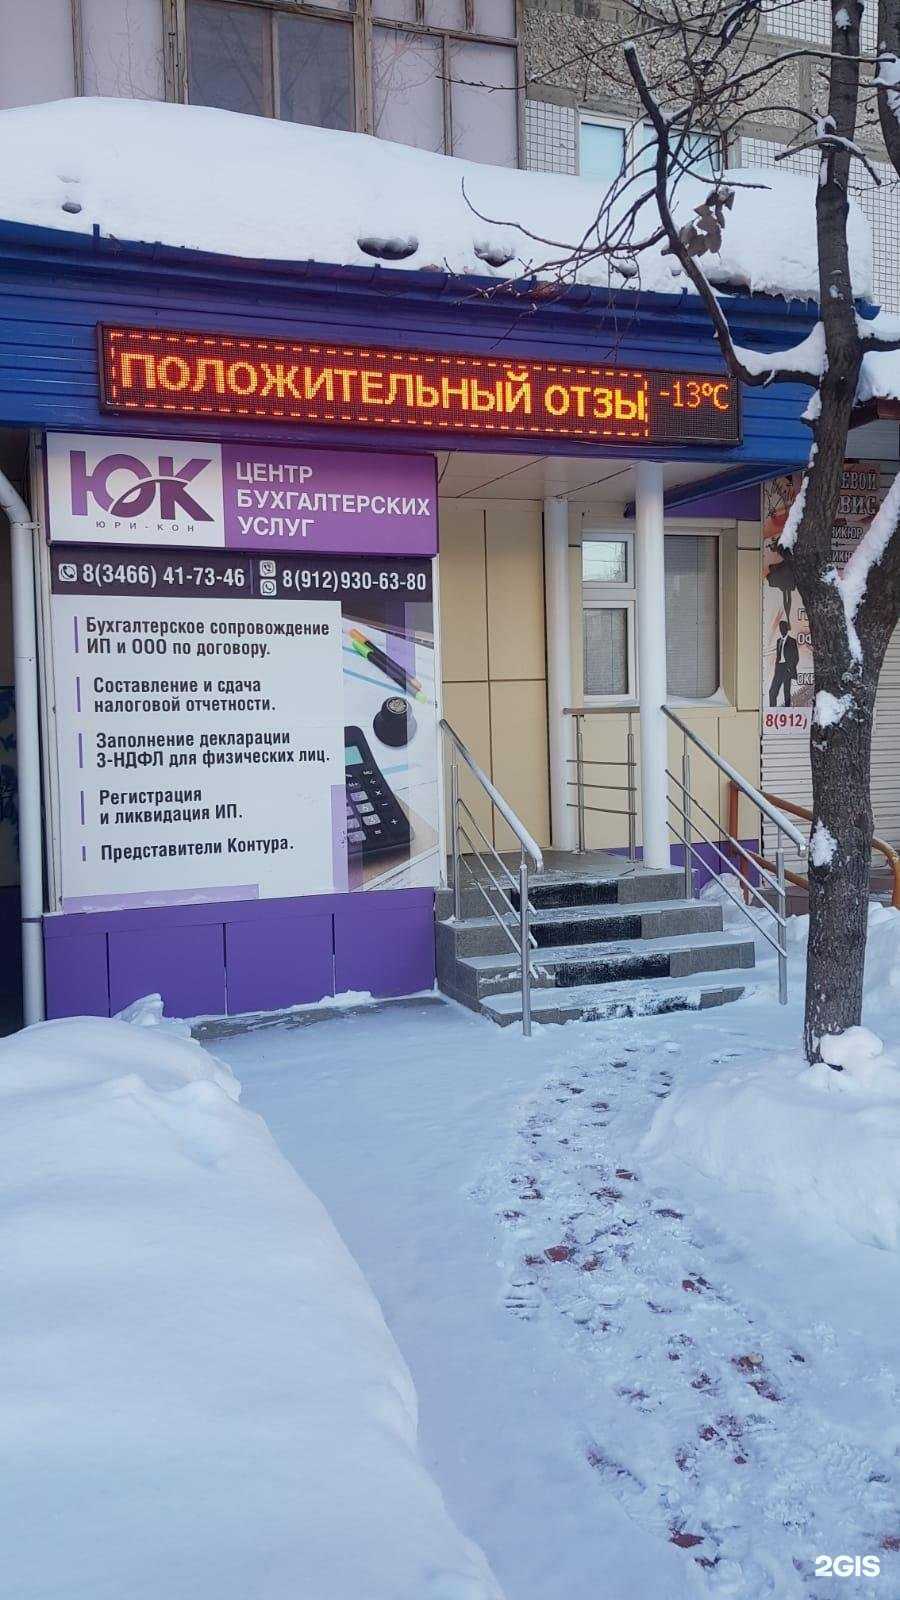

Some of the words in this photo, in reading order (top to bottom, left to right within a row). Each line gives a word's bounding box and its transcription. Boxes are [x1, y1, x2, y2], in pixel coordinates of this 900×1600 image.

[121, 352, 532, 414] ПОЛОЖИТЕЛЬНЫЙ
[544, 384, 645, 420] ОТЗЫ
[236, 461, 313, 485] ЦЕНТР
[237, 488, 430, 517] БУХГАЛТЕРСКИХ
[239, 516, 314, 537] УСЛУГ
[83, 564, 157, 585] 8(3466)
[163, 566, 245, 587] 41-73-46
[282, 569, 427, 592] 8(912)930-63-80
[86, 617, 205, 637] Бухгалтерское
[210, 620, 330, 636] сопровождение
[87, 639, 111, 654] ИП
[117, 642, 127, 654] и
[132, 639, 167, 654] ООО
[173, 643, 191, 654] по
[197, 643, 271, 658] договору.
[93, 677, 198, 693] Составление
[204, 682, 212, 692] и
[218, 681, 261, 694] сдача
[94, 697, 181, 713] налоговой
[186, 698, 276, 712] отчетности.
[96, 733, 195, 748] Заполнение
[200, 732, 291, 747] декларации
[96, 752, 164, 769] 3-НДФЛ
[169, 754, 197, 768] для
[202, 751, 294, 768] физических
[299, 751, 330, 765] лиц.
[99, 789, 202, 806] Регистрация
[100, 813, 109, 824] и
[115, 808, 210, 825] ликвидация
[215, 804, 243, 818] ИП.
[101, 841, 222, 863] Представители
[227, 837, 294, 855] Контура.
